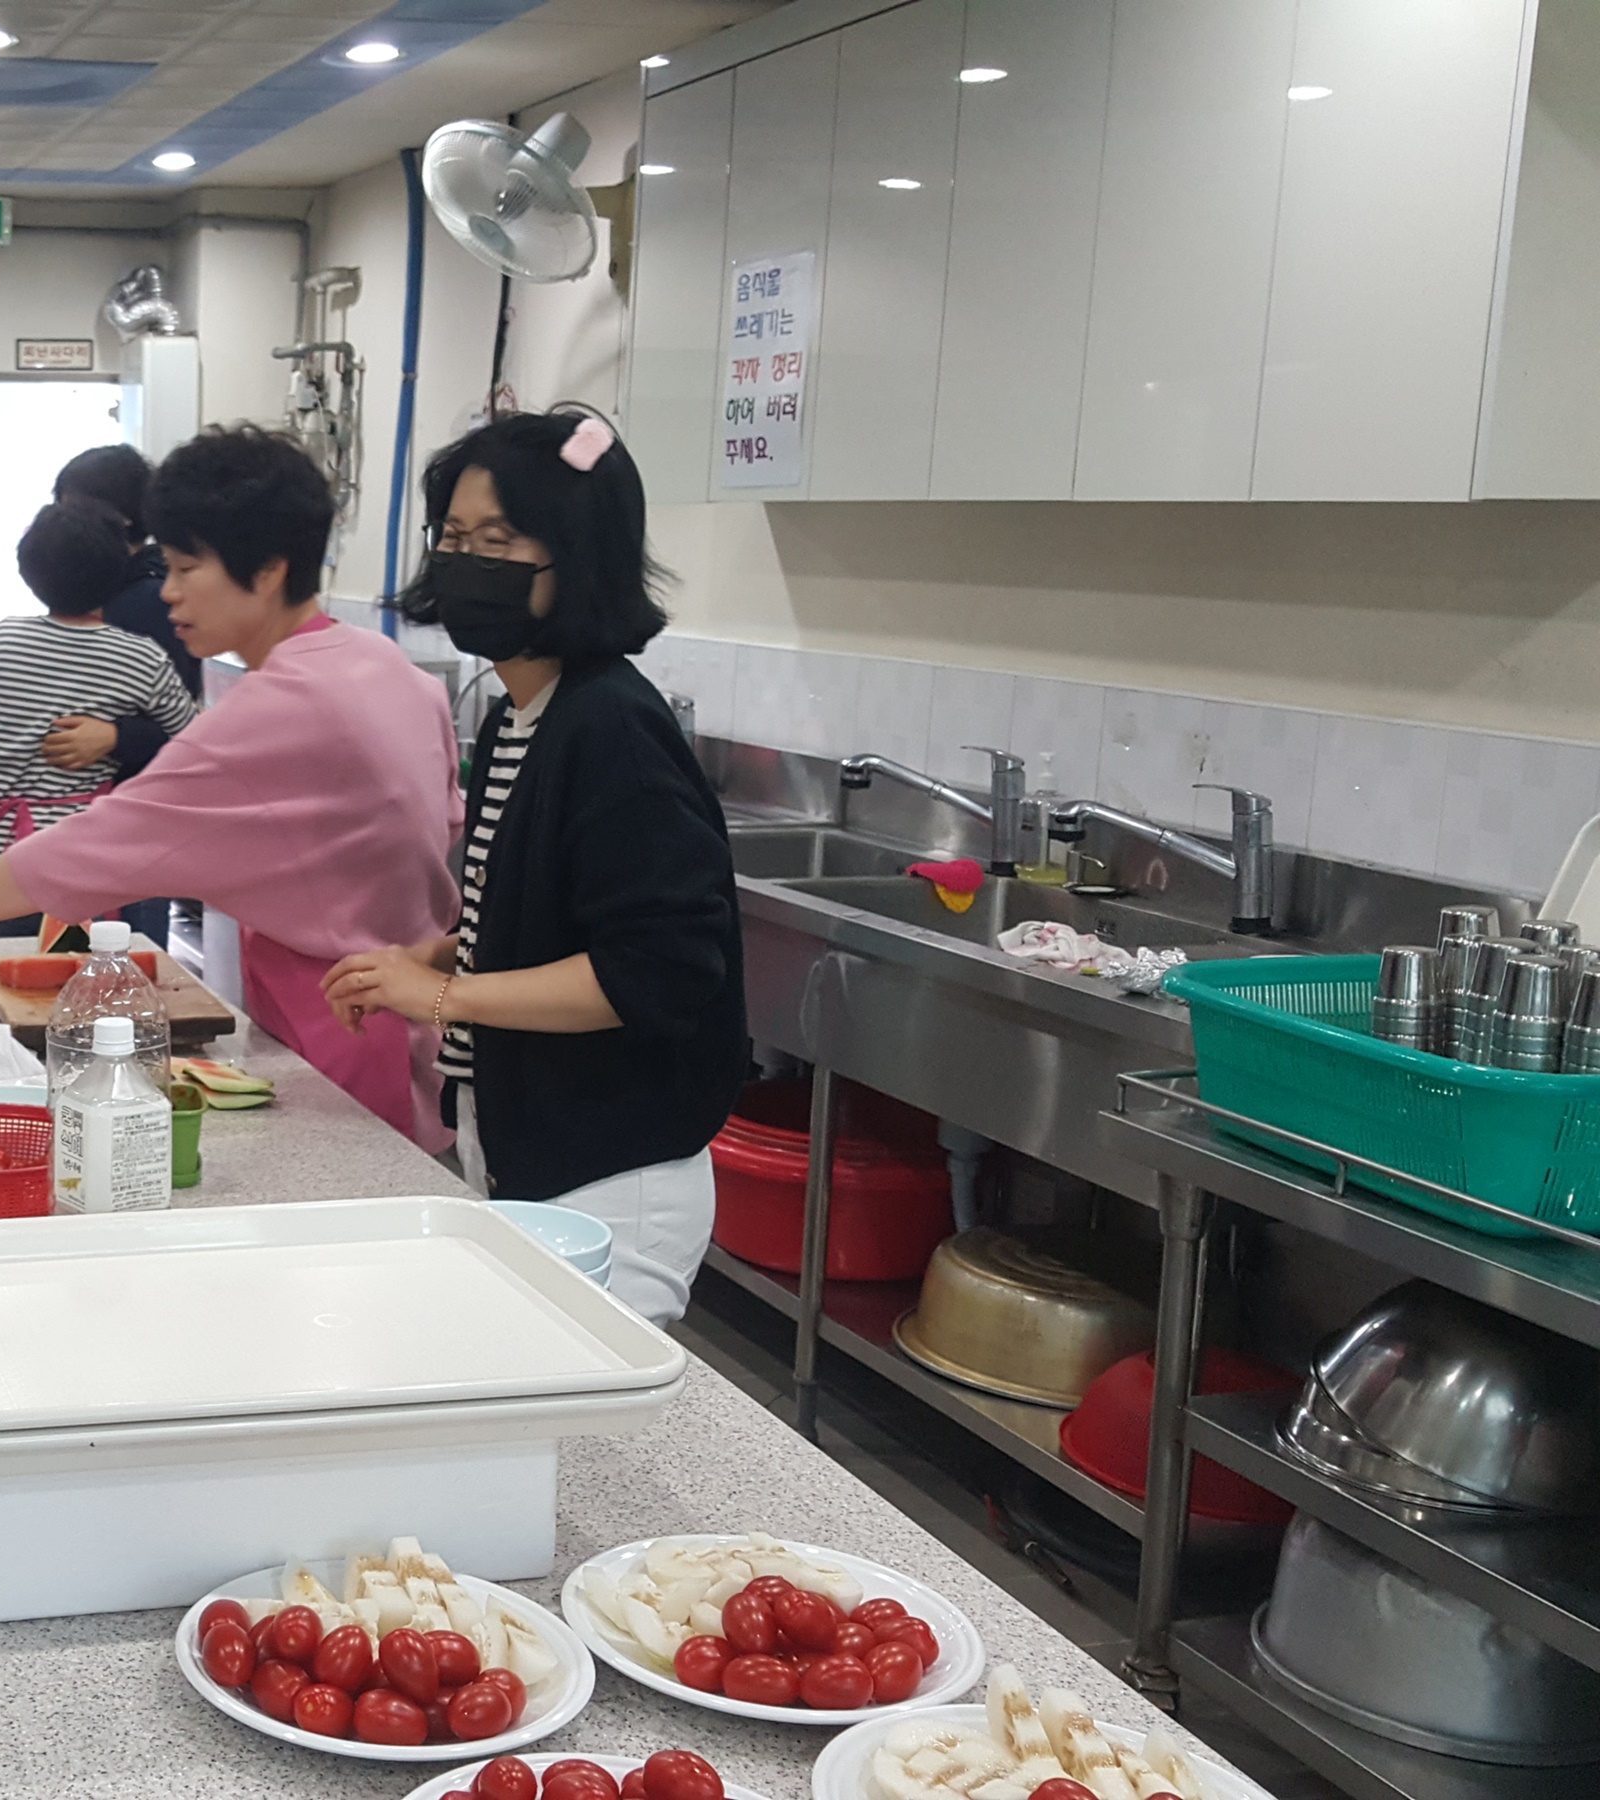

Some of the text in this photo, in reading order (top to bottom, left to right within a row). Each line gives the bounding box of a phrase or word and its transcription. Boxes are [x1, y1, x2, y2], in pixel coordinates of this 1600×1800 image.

[734, 308, 794, 339] 쓰레기는
[731, 356, 761, 385] 각자
[766, 392, 798, 422] 버려
[725, 436, 774, 465] 주세요.
